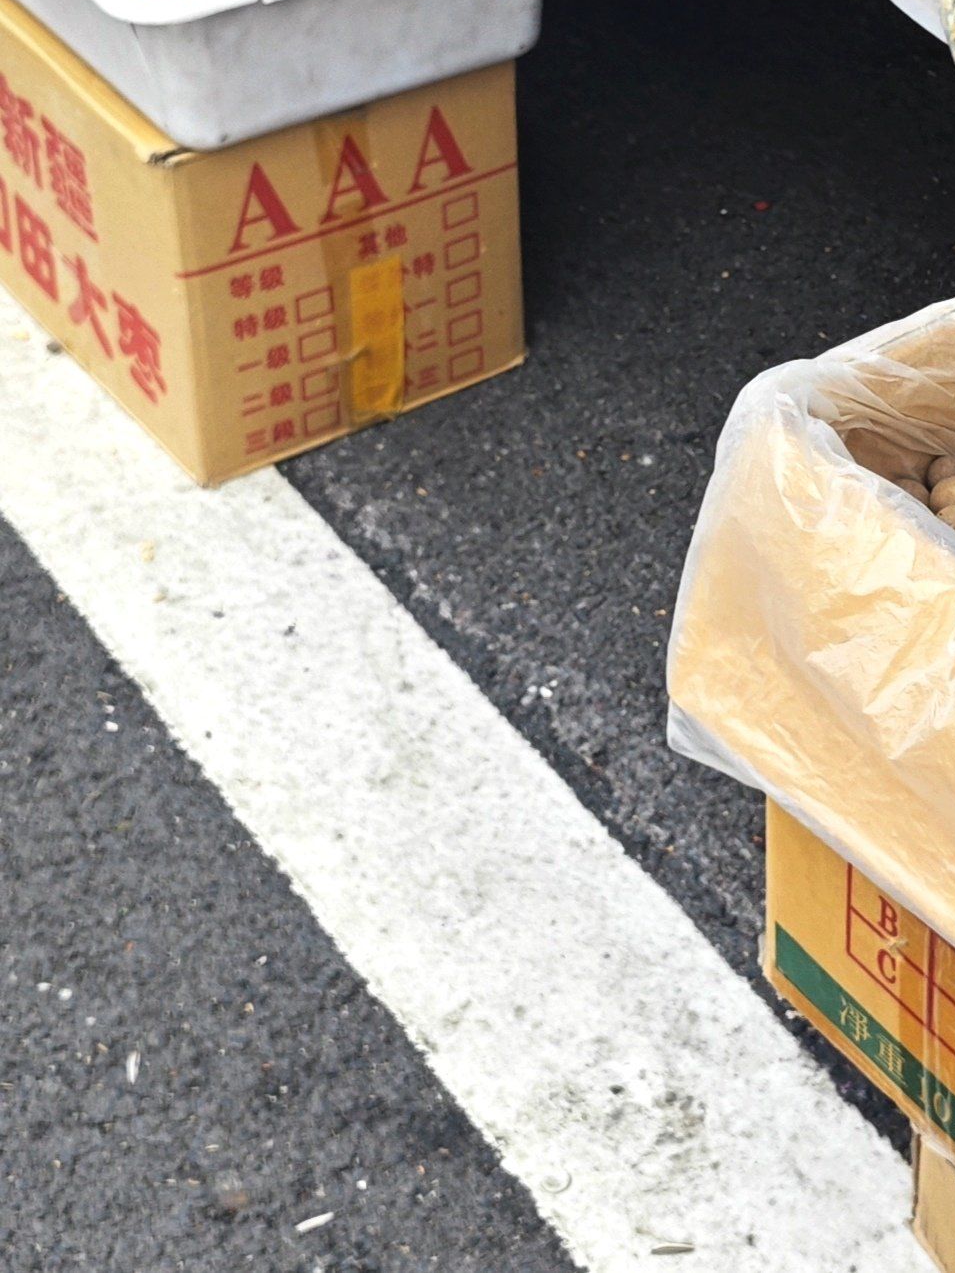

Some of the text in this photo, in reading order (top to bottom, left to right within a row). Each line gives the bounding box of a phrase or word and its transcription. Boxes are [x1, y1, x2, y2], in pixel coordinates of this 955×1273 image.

[0, 177, 168, 405] 田大枣
[878, 894, 898, 938] B
[877, 948, 897, 984] C
